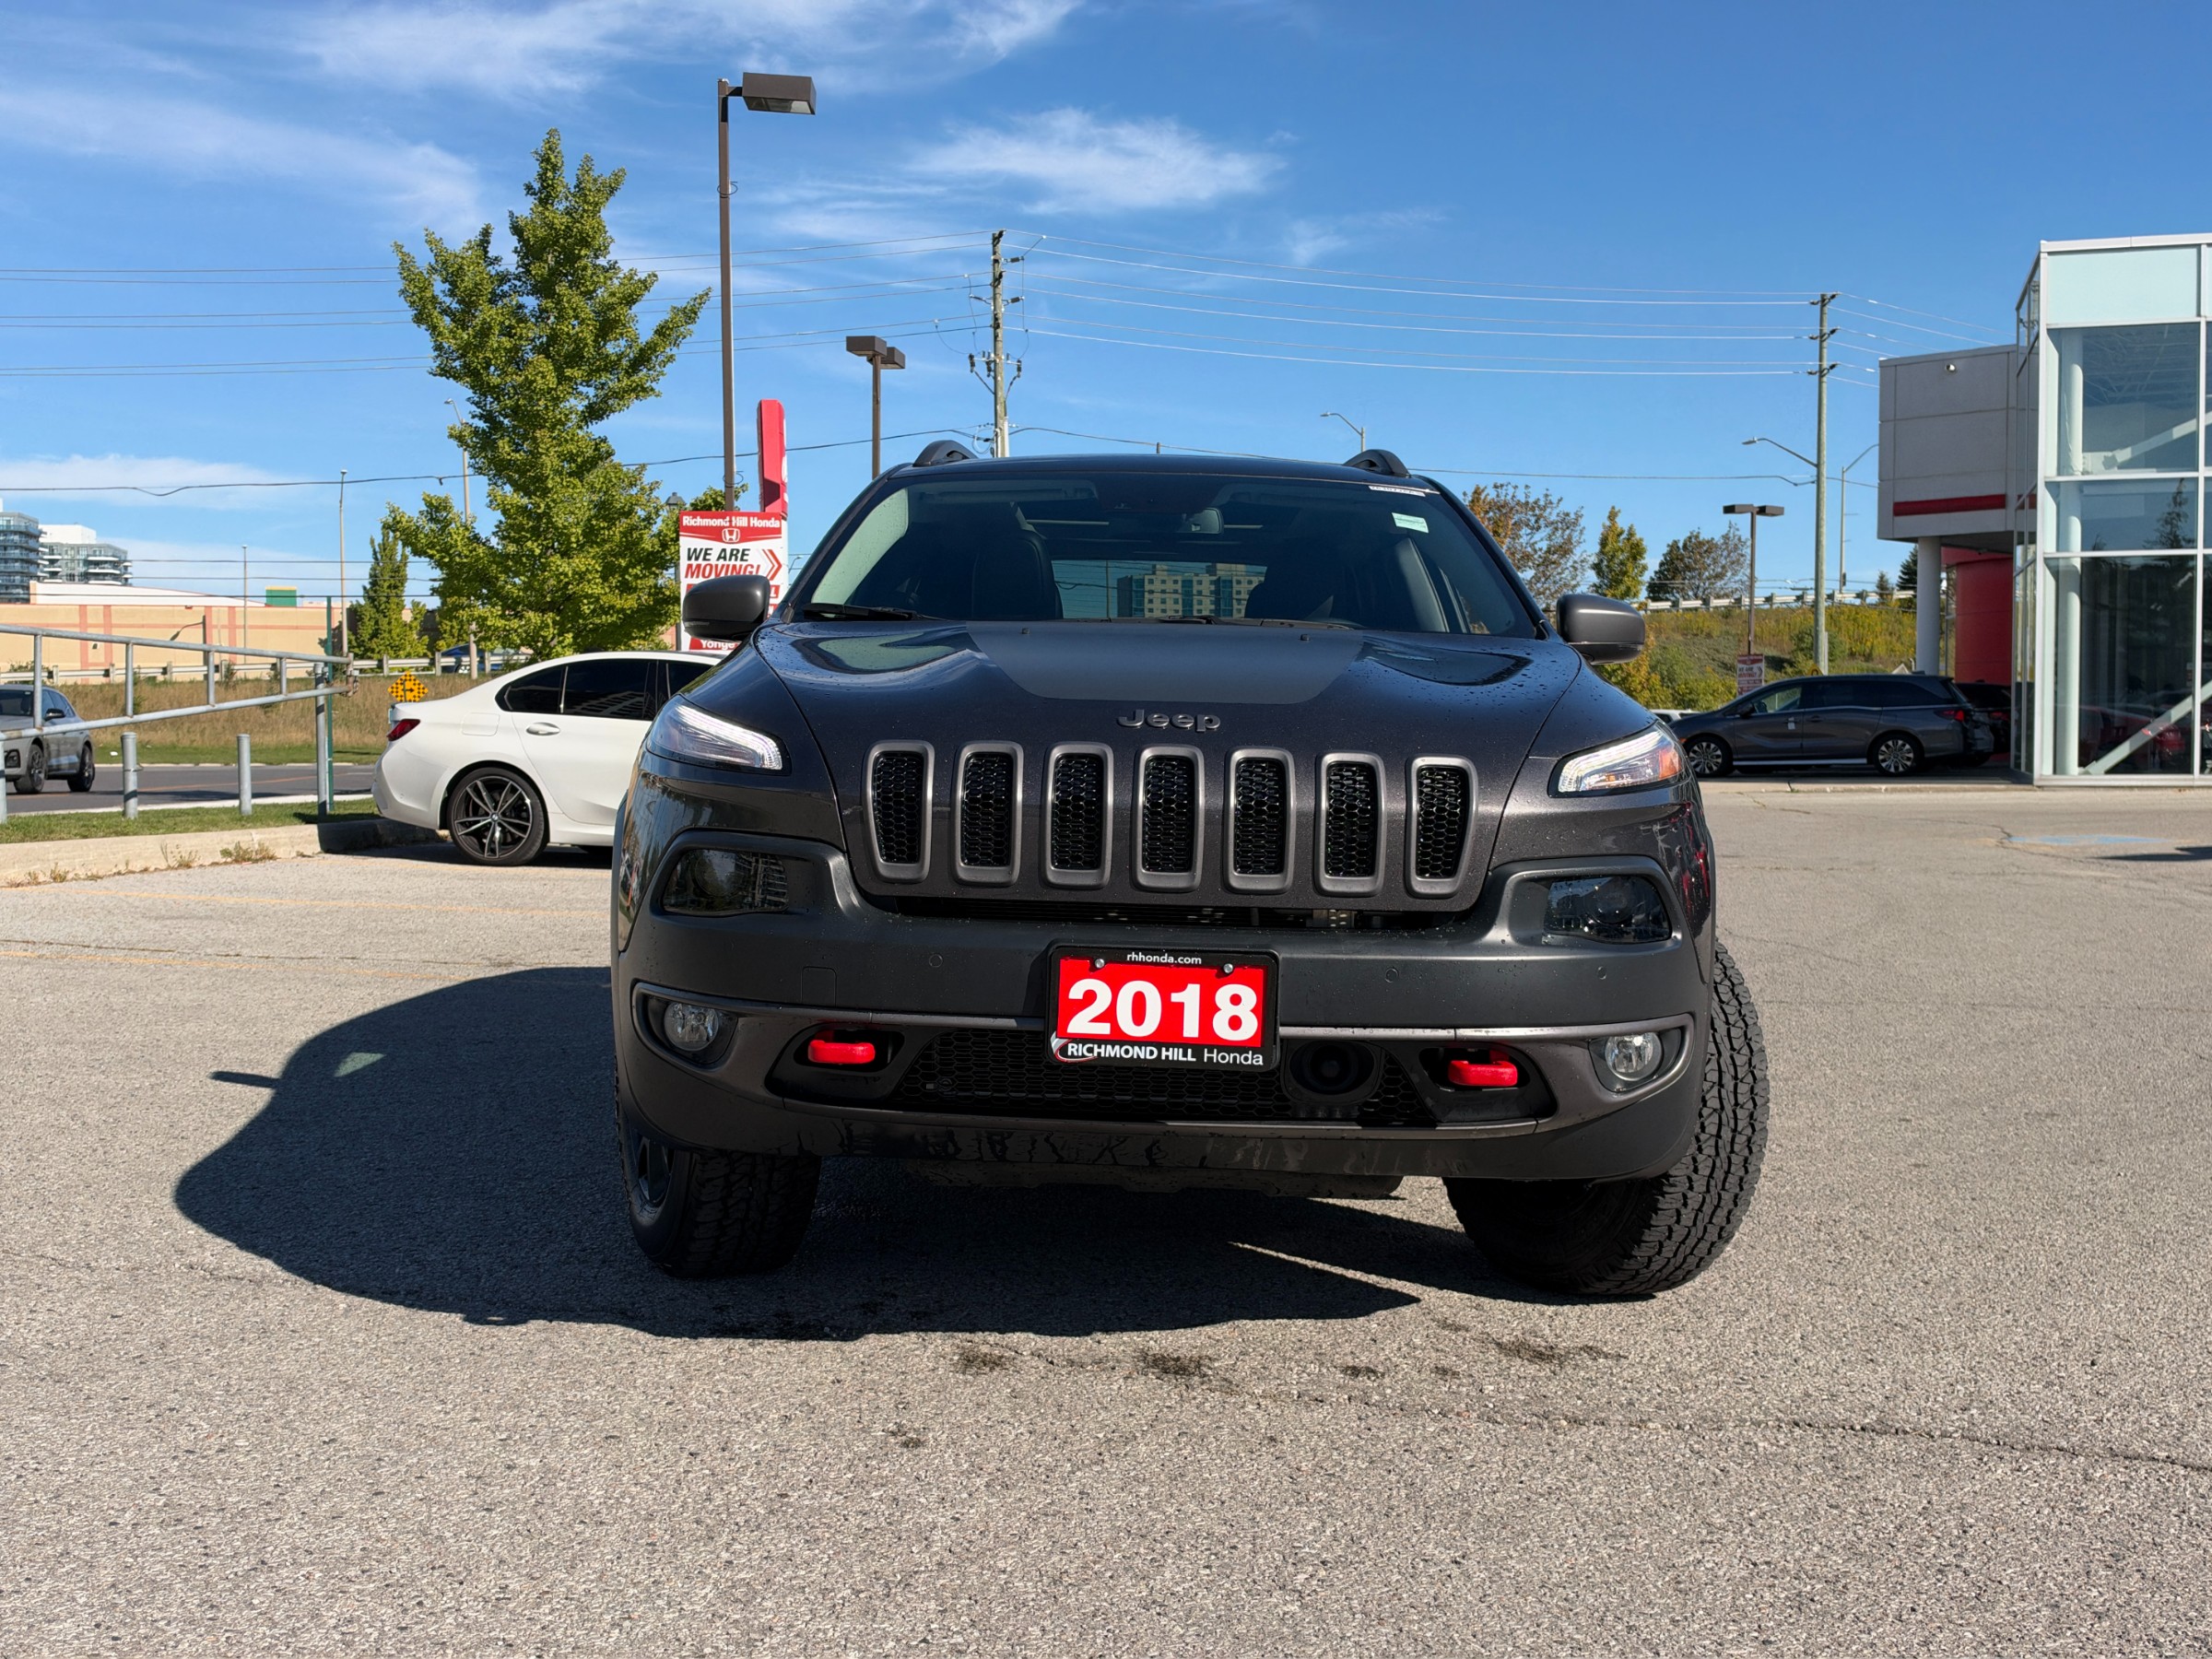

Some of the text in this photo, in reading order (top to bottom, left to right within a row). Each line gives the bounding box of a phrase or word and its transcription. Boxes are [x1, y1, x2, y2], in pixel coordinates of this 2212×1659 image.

[682, 515, 780, 527] Richmond Hill Honda
[687, 547, 751, 562] WE ARE
[700, 640, 735, 651] Yonge
[1117, 709, 1221, 733] Jeep
[1126, 951, 1202, 965] rhhonda.com
[1066, 978, 1259, 1041] 2018
[1067, 1042, 1264, 1065] RICHMOND HILL Honda
